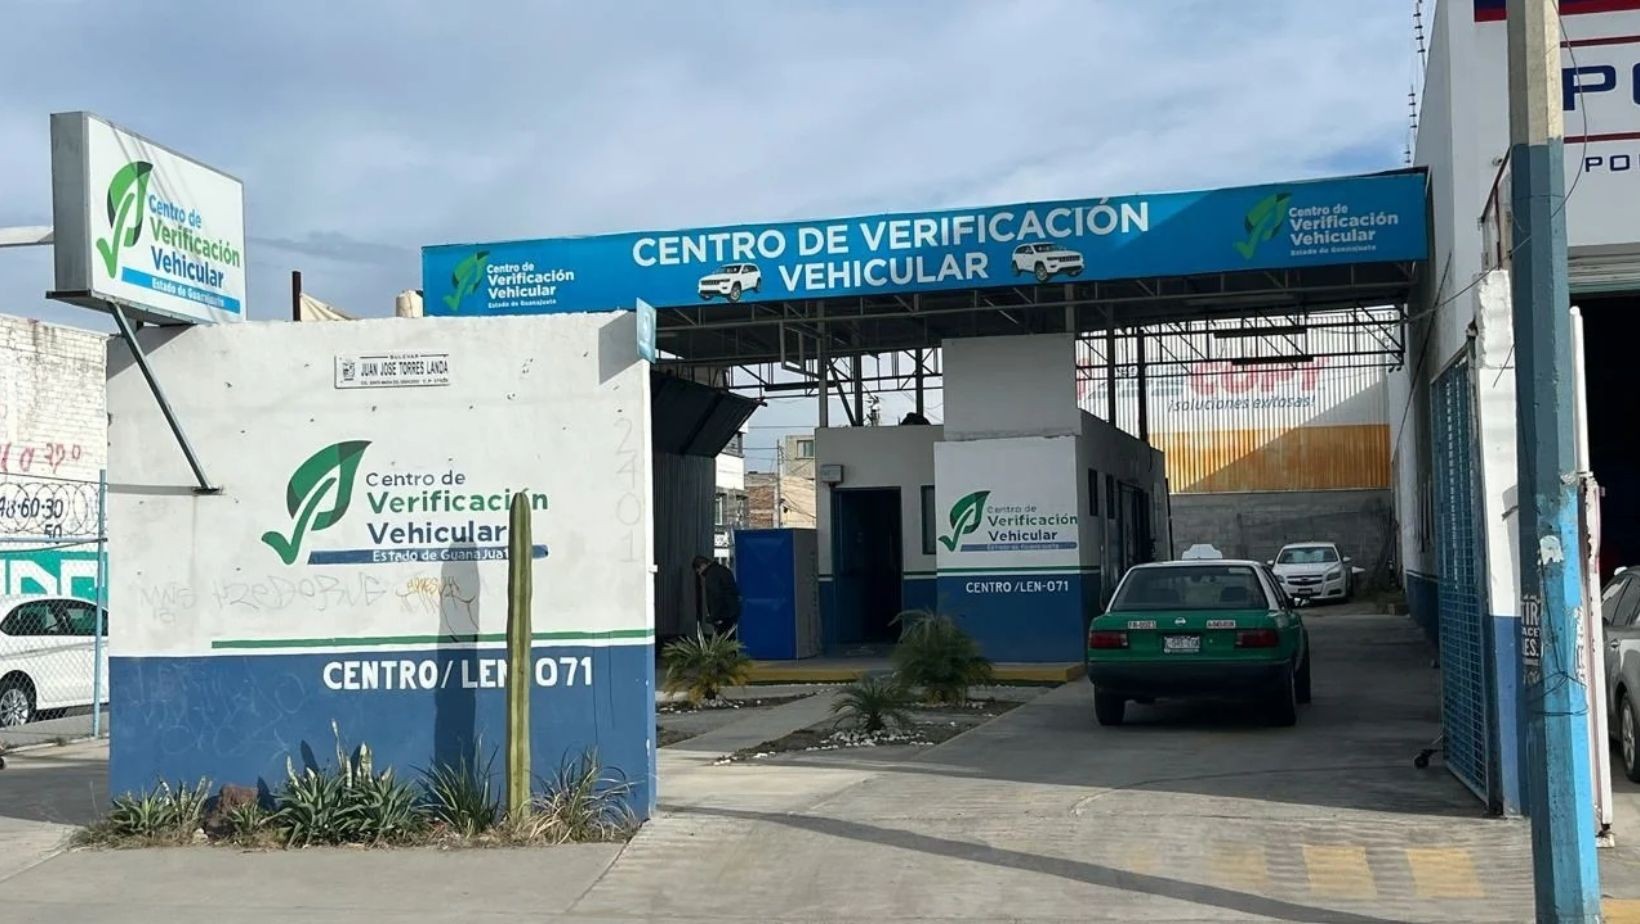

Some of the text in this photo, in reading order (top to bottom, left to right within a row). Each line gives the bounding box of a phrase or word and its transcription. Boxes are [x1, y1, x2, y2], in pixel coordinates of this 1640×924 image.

[149, 194, 202, 228] Centro de
[1288, 203, 1348, 217] Centro de
[1290, 212, 1398, 231] Verificación
[632, 197, 1149, 267] CENTRO DE VERIFICACIÓN
[1291, 229, 1376, 246] Vehicular
[150, 216, 240, 267] Verificación
[151, 245, 224, 288] Vehicular
[486, 261, 535, 274] Centro de
[778, 251, 990, 292] VEHICULAR
[487, 269, 575, 286] Verificación
[488, 284, 556, 299] Vehicular
[361, 362, 378, 376] JUAN
[399, 361, 424, 375] TORRES
[426, 359, 448, 374] LANDA
[366, 470, 466, 486] Centro de
[367, 487, 548, 514] Verificacin
[987, 504, 1037, 514] Centro de
[988, 512, 1078, 527] Verificación
[367, 520, 507, 545] Vehicular
[988, 529, 1058, 542] Vehicular
[372, 550, 417, 562] Estado
[421, 548, 438, 561] de
[966, 581, 1012, 594] CENTRO
